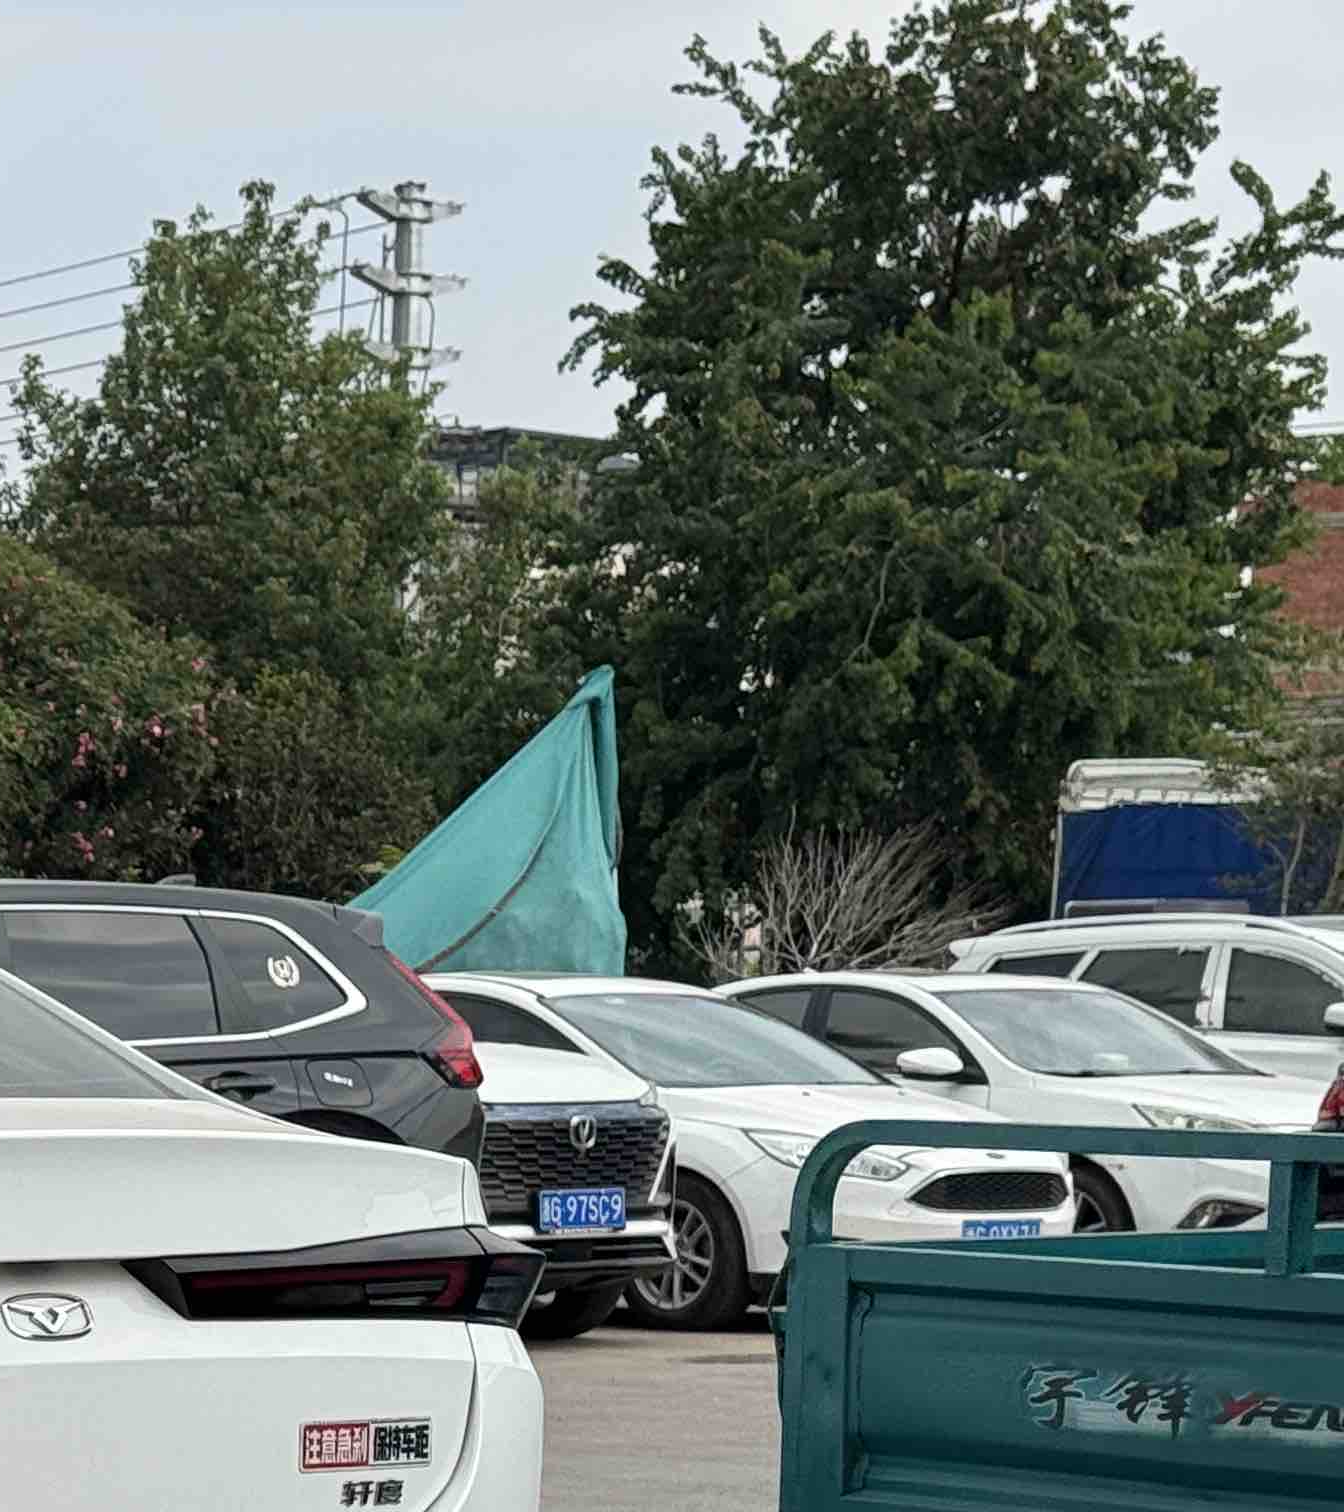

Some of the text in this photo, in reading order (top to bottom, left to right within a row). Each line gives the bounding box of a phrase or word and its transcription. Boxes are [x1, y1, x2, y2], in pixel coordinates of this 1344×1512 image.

[304, 1424, 430, 1465] 注意急刹 保持车距
[340, 1478, 405, 1507] 轩度
